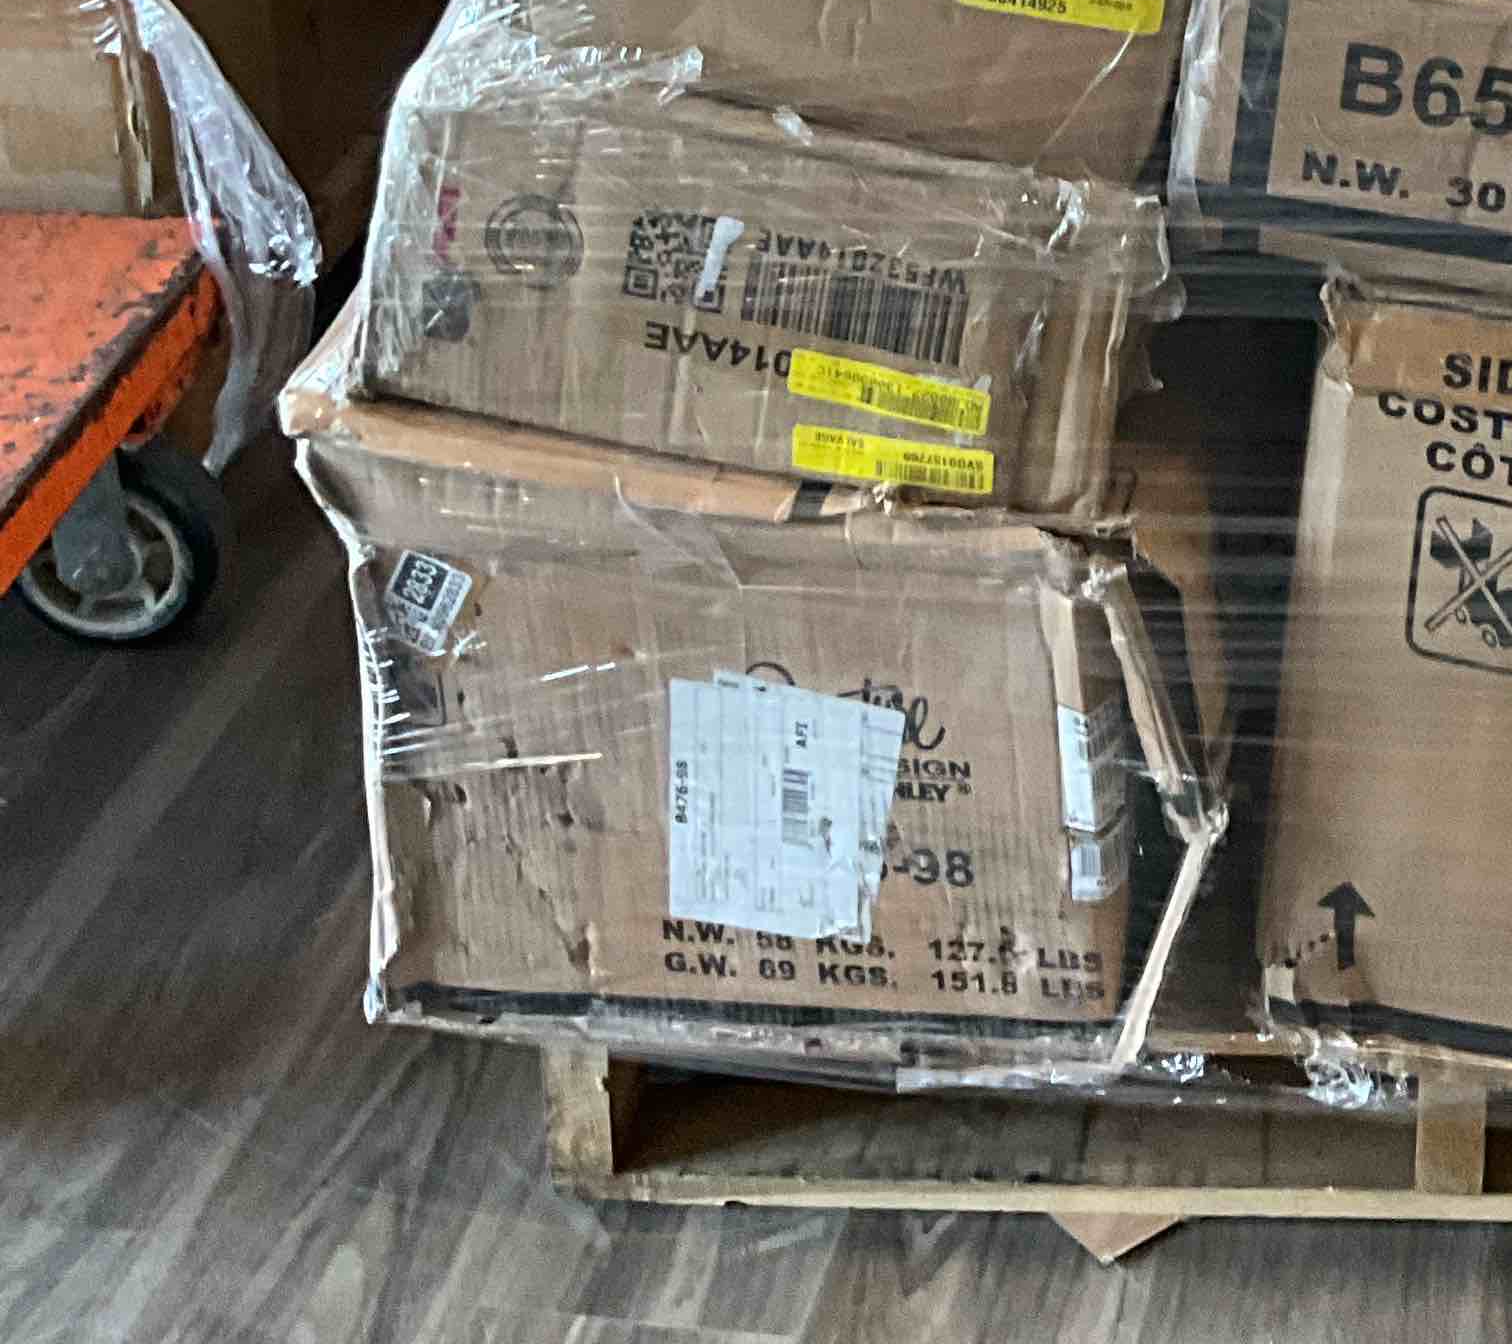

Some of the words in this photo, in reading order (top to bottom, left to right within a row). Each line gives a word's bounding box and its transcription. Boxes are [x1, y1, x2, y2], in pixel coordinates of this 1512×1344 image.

[1302, 148, 1410, 199] N.W.
[1445, 175, 1507, 213] 30
[880, 847, 976, 888] -98
[661, 919, 735, 947] N.W.
[663, 951, 738, 980] G.W.
[758, 958, 797, 982] 69
[818, 961, 898, 987] KGS.
